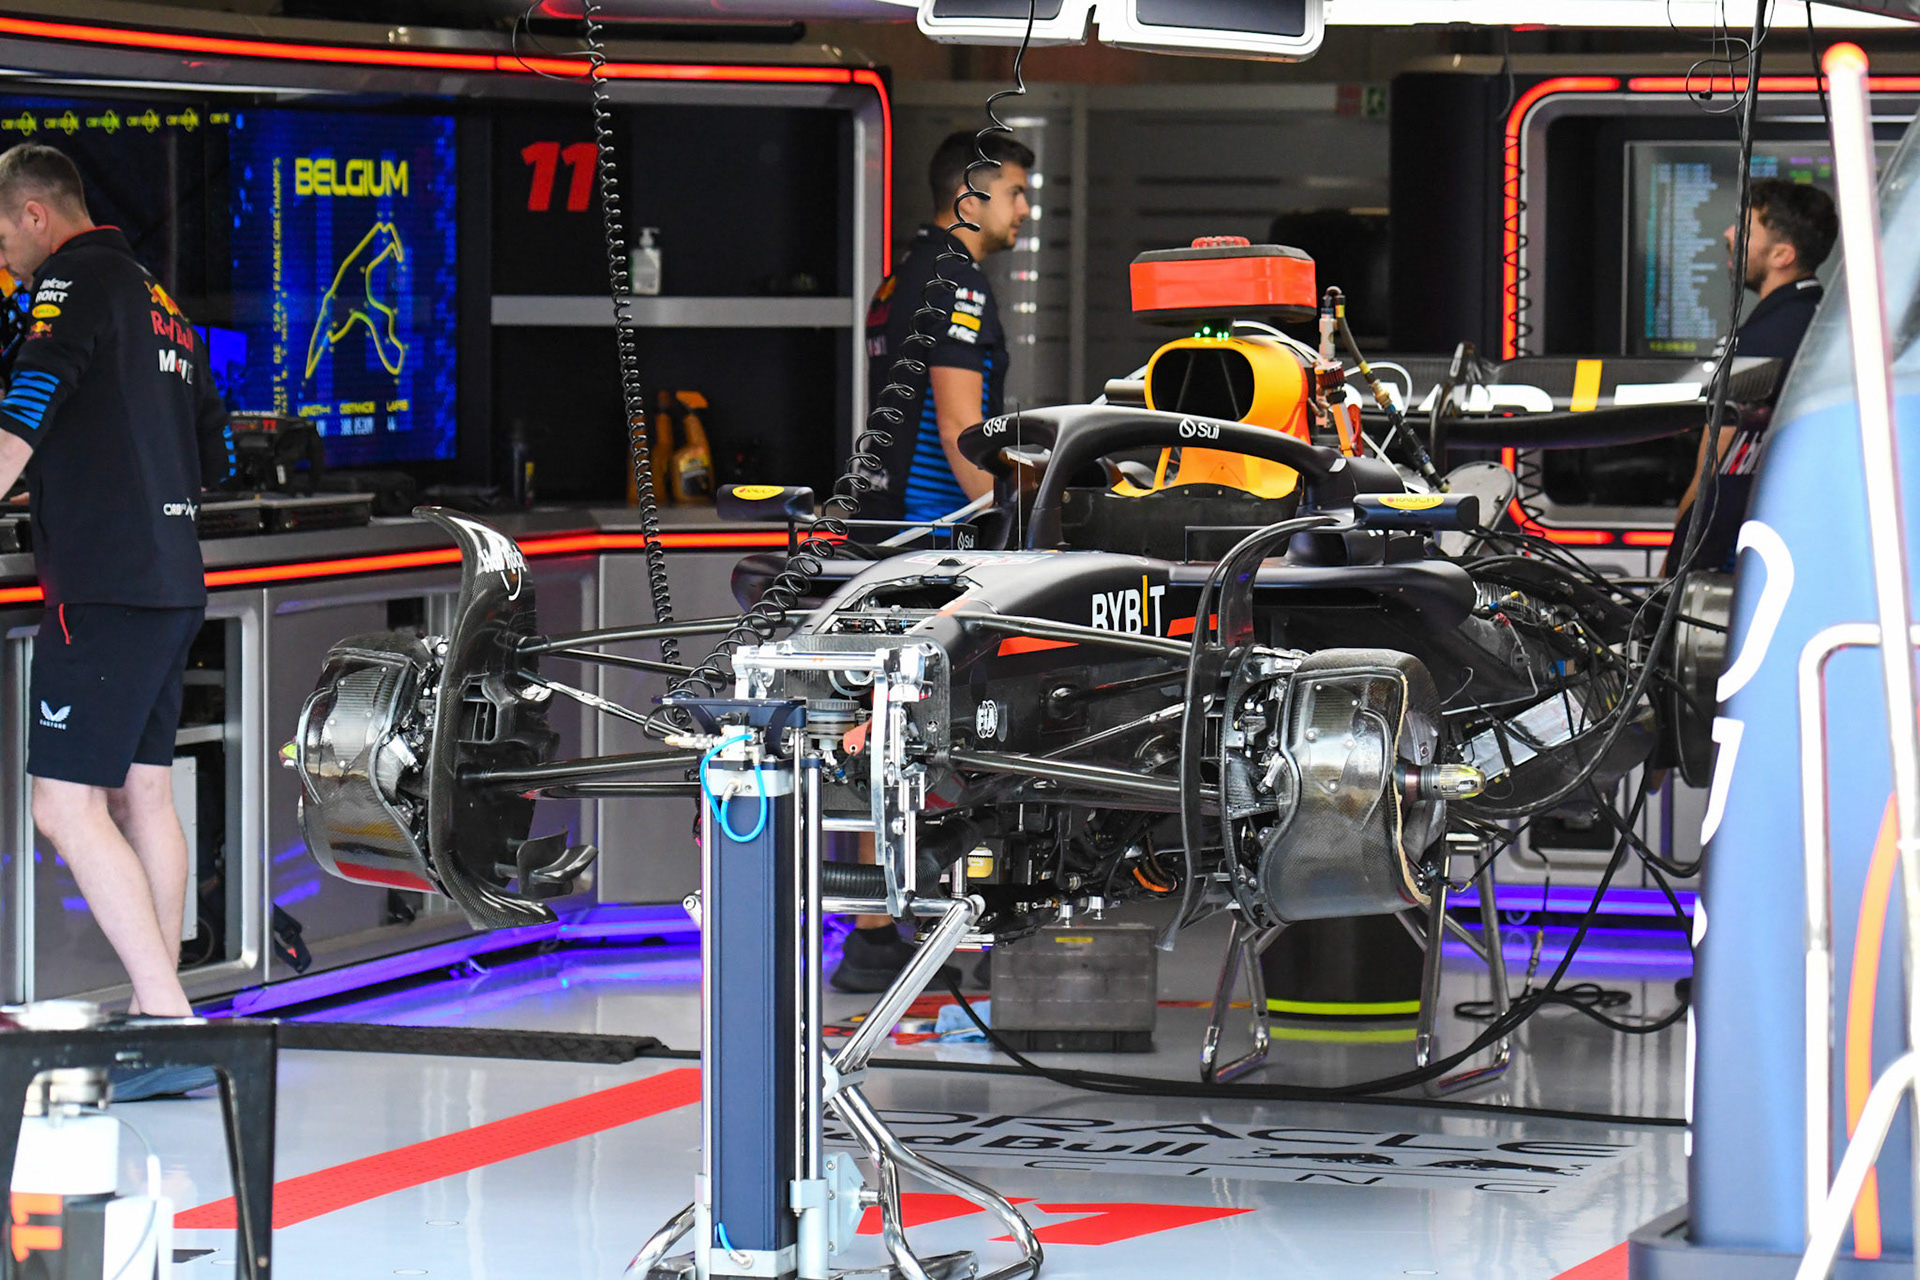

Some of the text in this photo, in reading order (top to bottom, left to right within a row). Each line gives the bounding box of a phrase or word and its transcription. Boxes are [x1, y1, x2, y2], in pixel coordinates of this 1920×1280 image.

[295, 158, 408, 197] BELGIUM
[521, 141, 599, 212] 11
[273, 157, 281, 332] SPA-FRANCORCHAMPS
[993, 416, 1010, 434] Sui
[1197, 422, 1220, 440] Sui
[1395, 496, 1436, 504] RAUCH
[964, 534, 975, 549] Sui
[1092, 574, 1165, 638] BYBIT
[823, 1109, 1638, 1159] ORACLE
[978, 1134, 1210, 1157] Bull
[10, 1191, 63, 1263] 11
